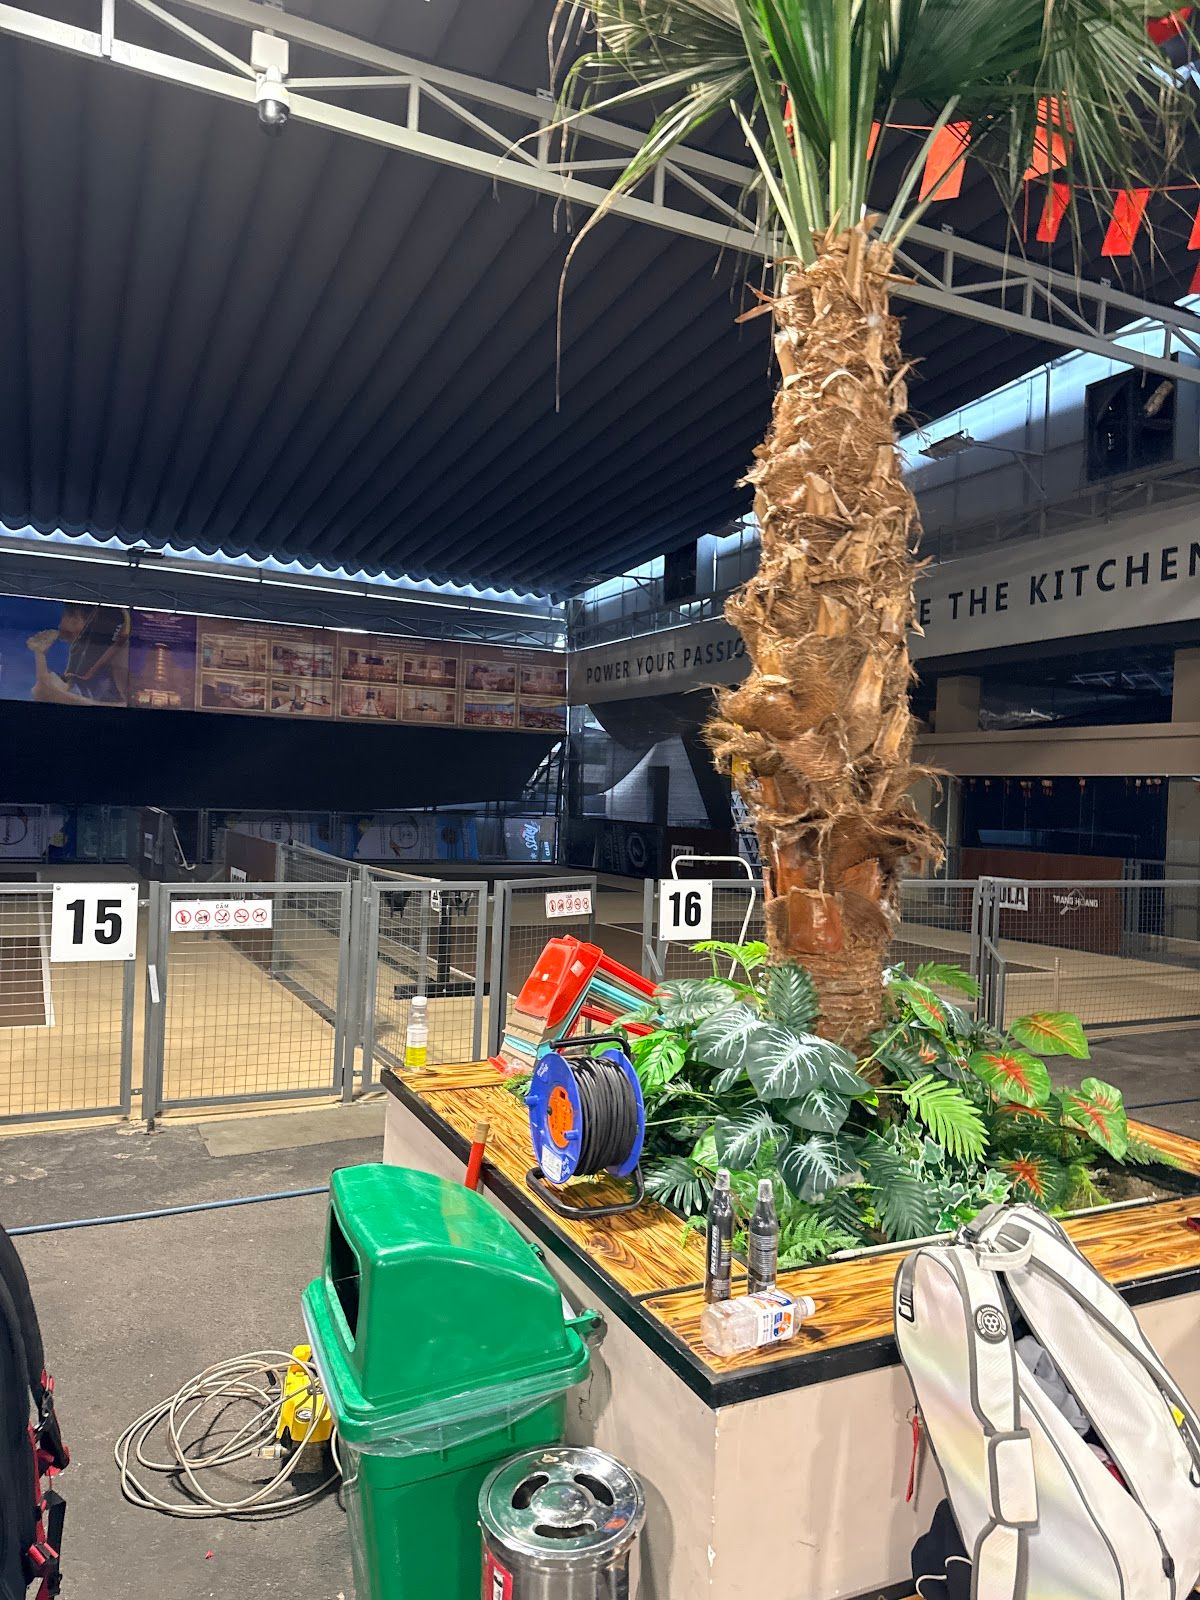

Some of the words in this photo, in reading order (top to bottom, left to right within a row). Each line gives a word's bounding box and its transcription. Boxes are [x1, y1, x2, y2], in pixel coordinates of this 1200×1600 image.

[948, 582, 1009, 619] THE
[587, 660, 630, 683] POWER
[637, 651, 675, 675] YOUR
[683, 637, 746, 667] PASSIO
[66, 899, 122, 945] 15
[669, 891, 702, 927] 16
